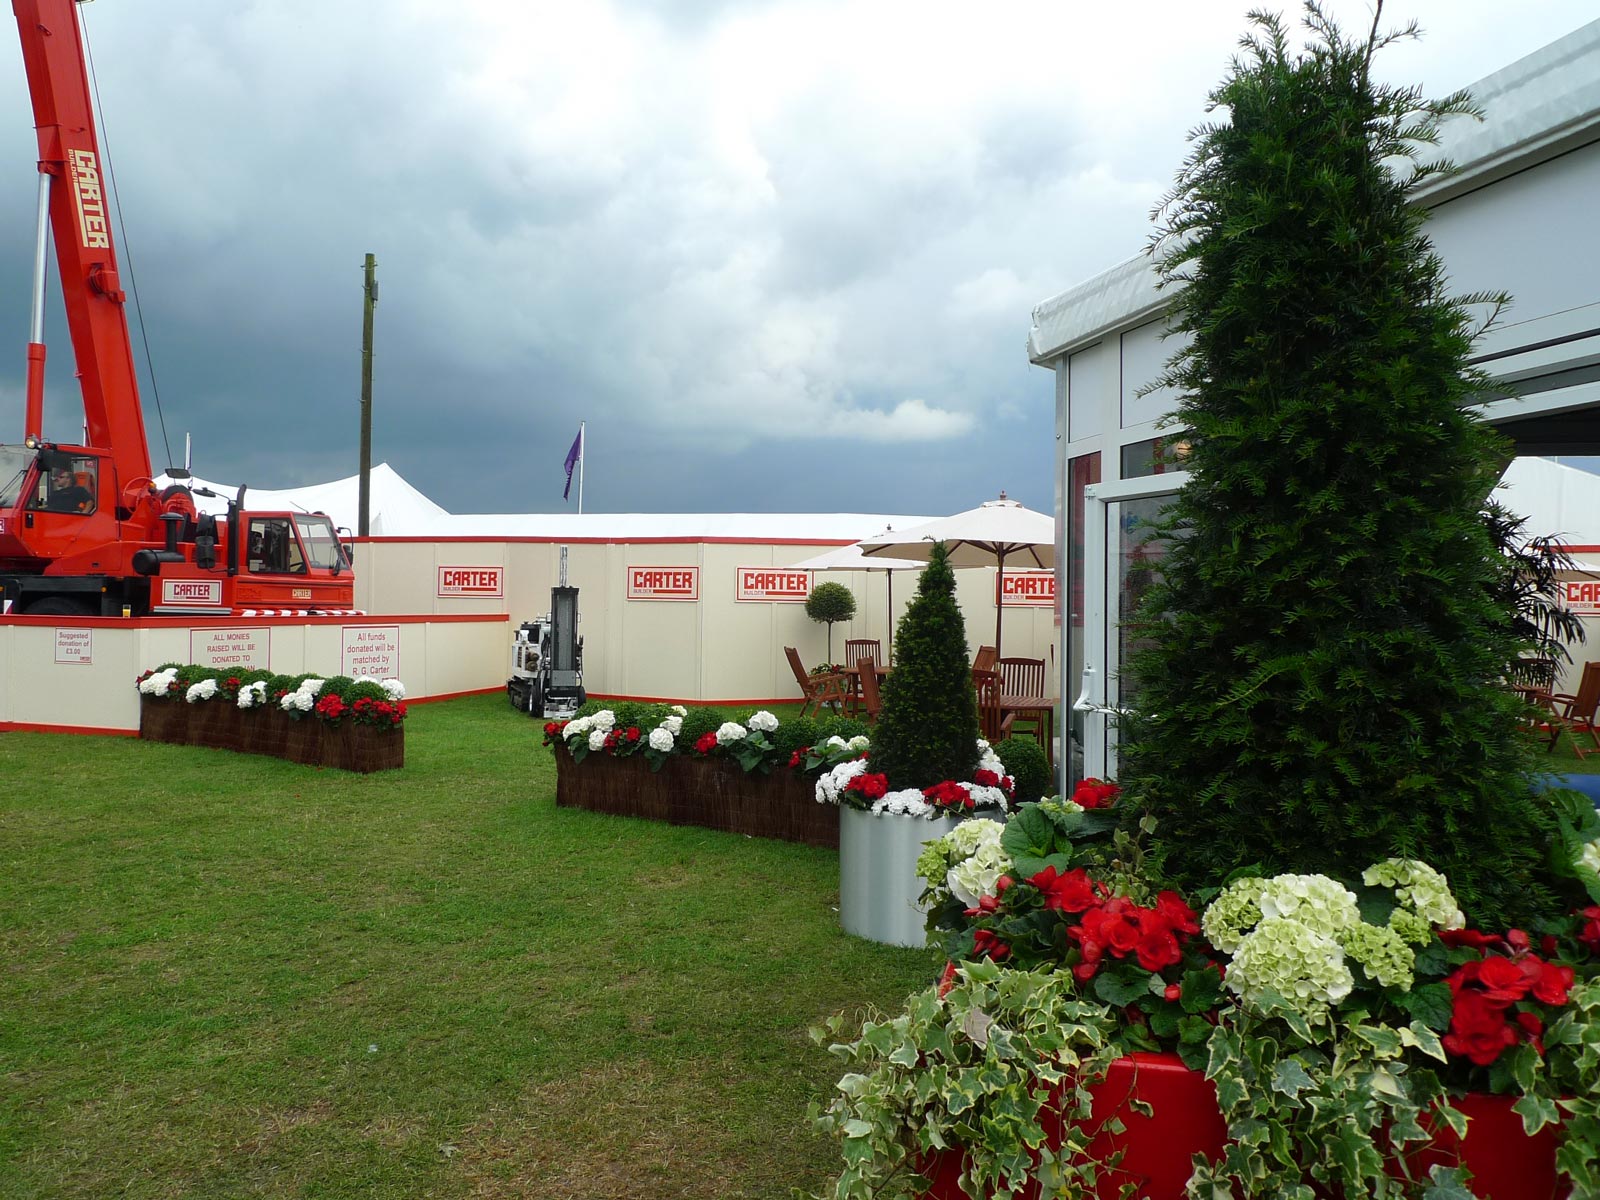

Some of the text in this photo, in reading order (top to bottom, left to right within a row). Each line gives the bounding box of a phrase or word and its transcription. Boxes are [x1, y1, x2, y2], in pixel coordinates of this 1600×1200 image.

[74, 149, 110, 248] CARTER
[443, 571, 498, 586] CARTER
[633, 571, 693, 588] CARTER
[743, 573, 808, 590] CARTER
[173, 584, 210, 596] CARTER
[226, 633, 250, 641] MONIES
[358, 633, 385, 641] All funds
[206, 645, 230, 653] RAISED
[247, 643, 256, 651] BE
[347, 643, 394, 653] donated will be
[211, 655, 241, 664] DONATED
[352, 655, 389, 664] matched by
[370, 666, 389, 674] Carter
